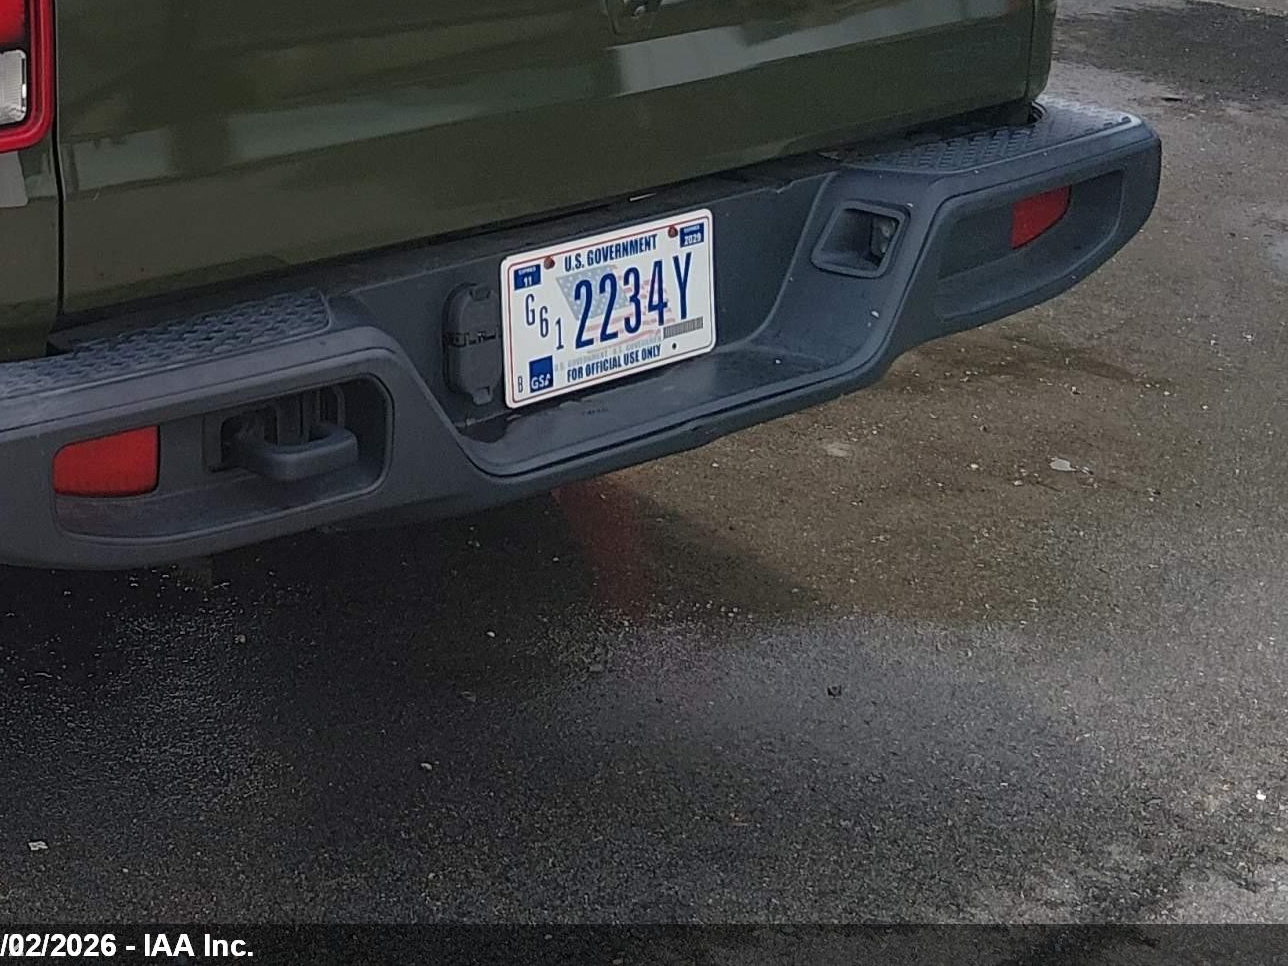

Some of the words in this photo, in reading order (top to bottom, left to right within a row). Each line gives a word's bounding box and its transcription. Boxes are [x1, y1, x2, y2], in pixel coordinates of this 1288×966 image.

[564, 252, 585, 272] U.S.
[587, 233, 657, 267] GOVERNMENT
[523, 275, 532, 287] 11
[574, 252, 692, 349] 2234Y
[567, 366, 584, 383] FOR
[585, 356, 622, 378] OFFICIAL
[623, 349, 639, 366] USE
[641, 343, 661, 362] ONLY
